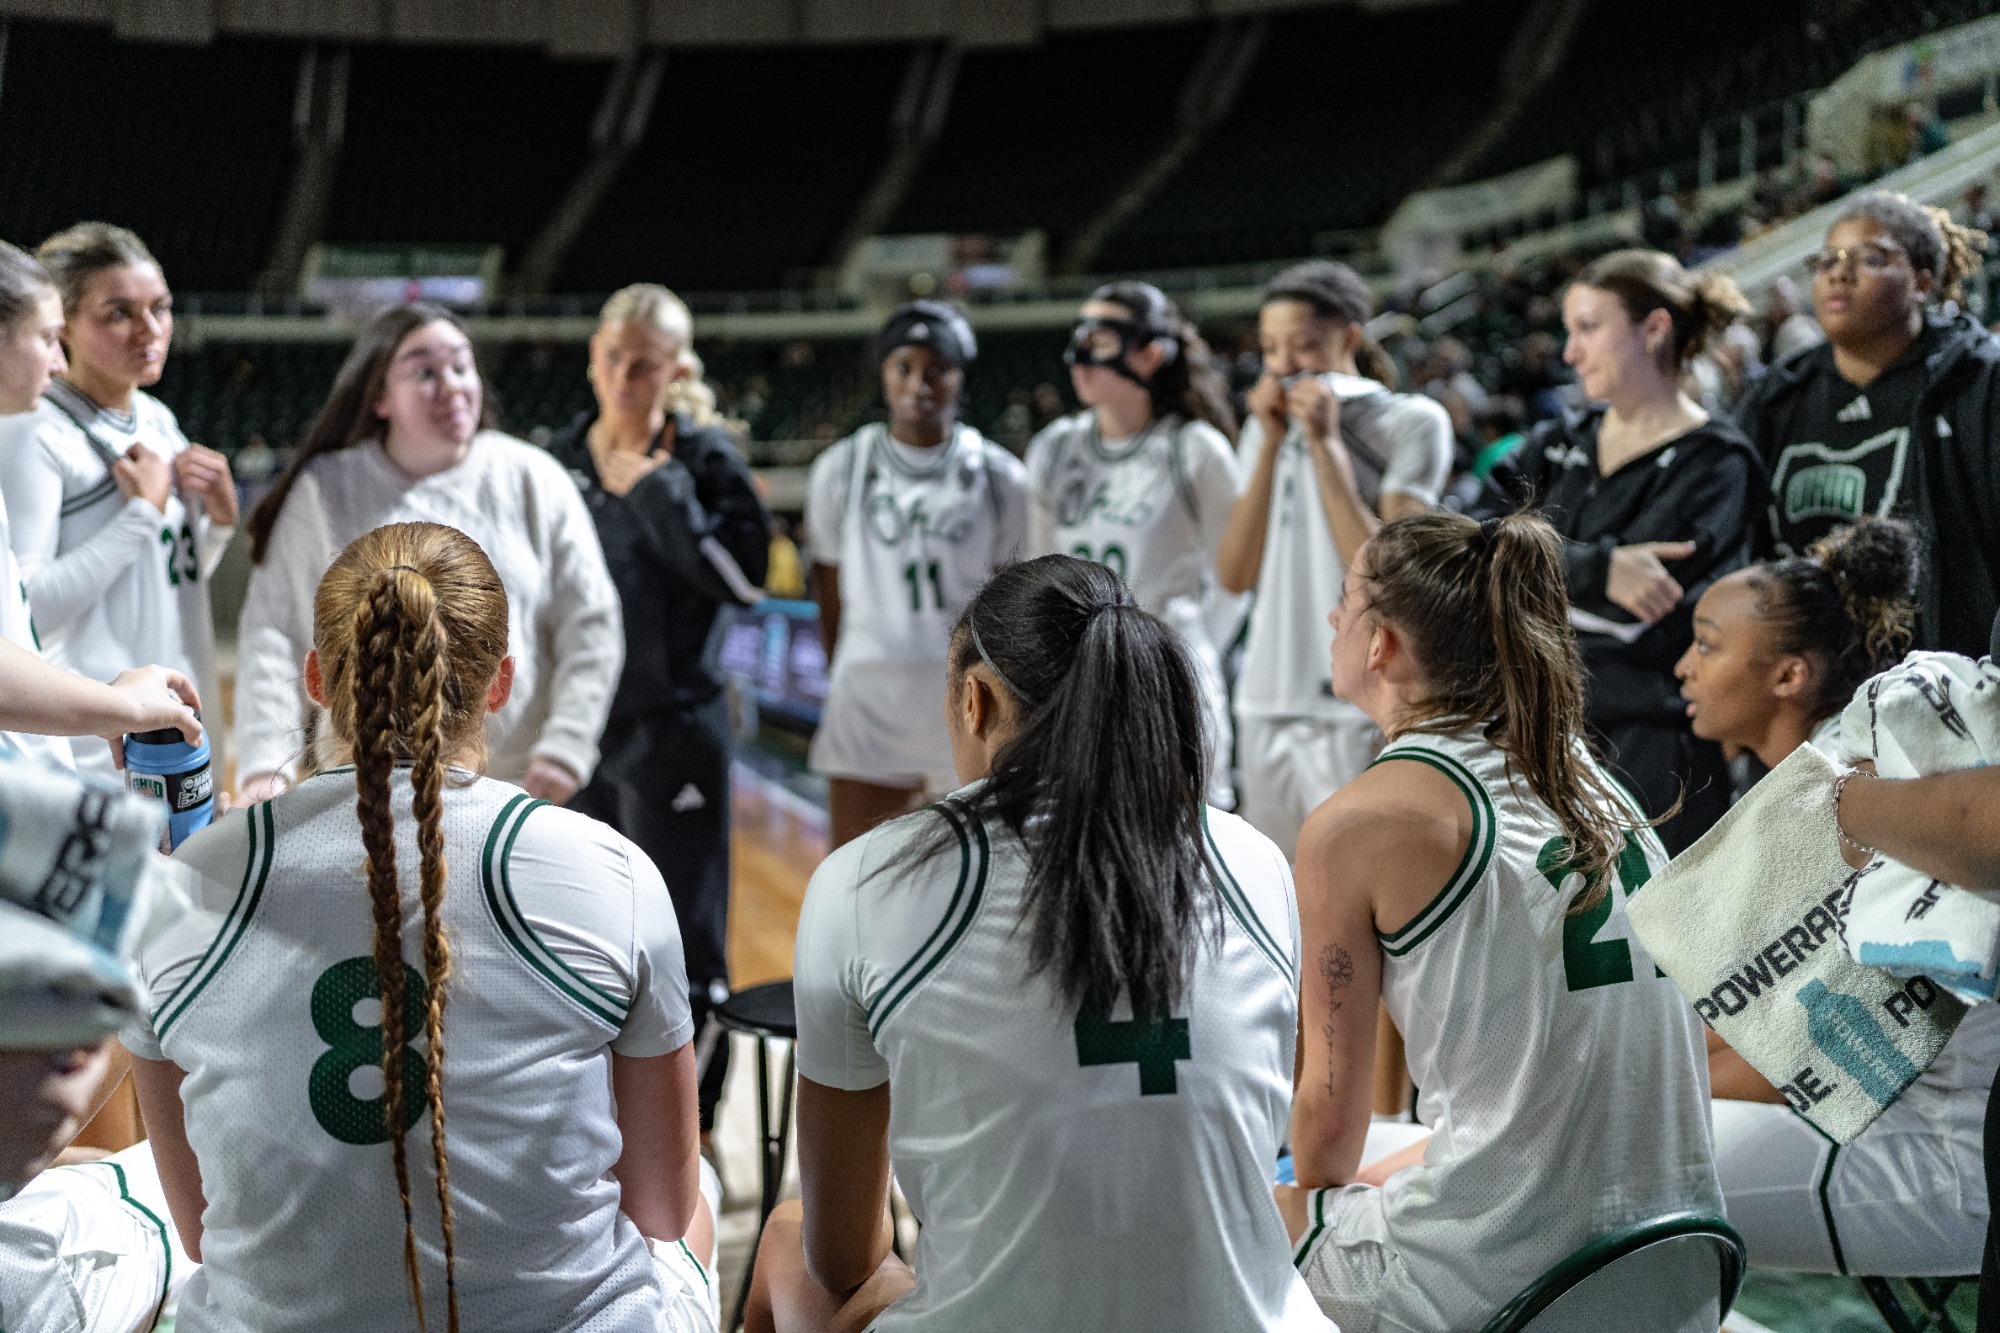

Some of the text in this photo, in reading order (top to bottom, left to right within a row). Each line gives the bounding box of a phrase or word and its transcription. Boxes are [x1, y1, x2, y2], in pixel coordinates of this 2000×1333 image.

[1789, 470, 1860, 515] OHIO
[161, 525, 198, 585] 23
[904, 559, 944, 610] 11
[309, 956, 430, 1145] 8
[1074, 975, 1191, 1095] 4
